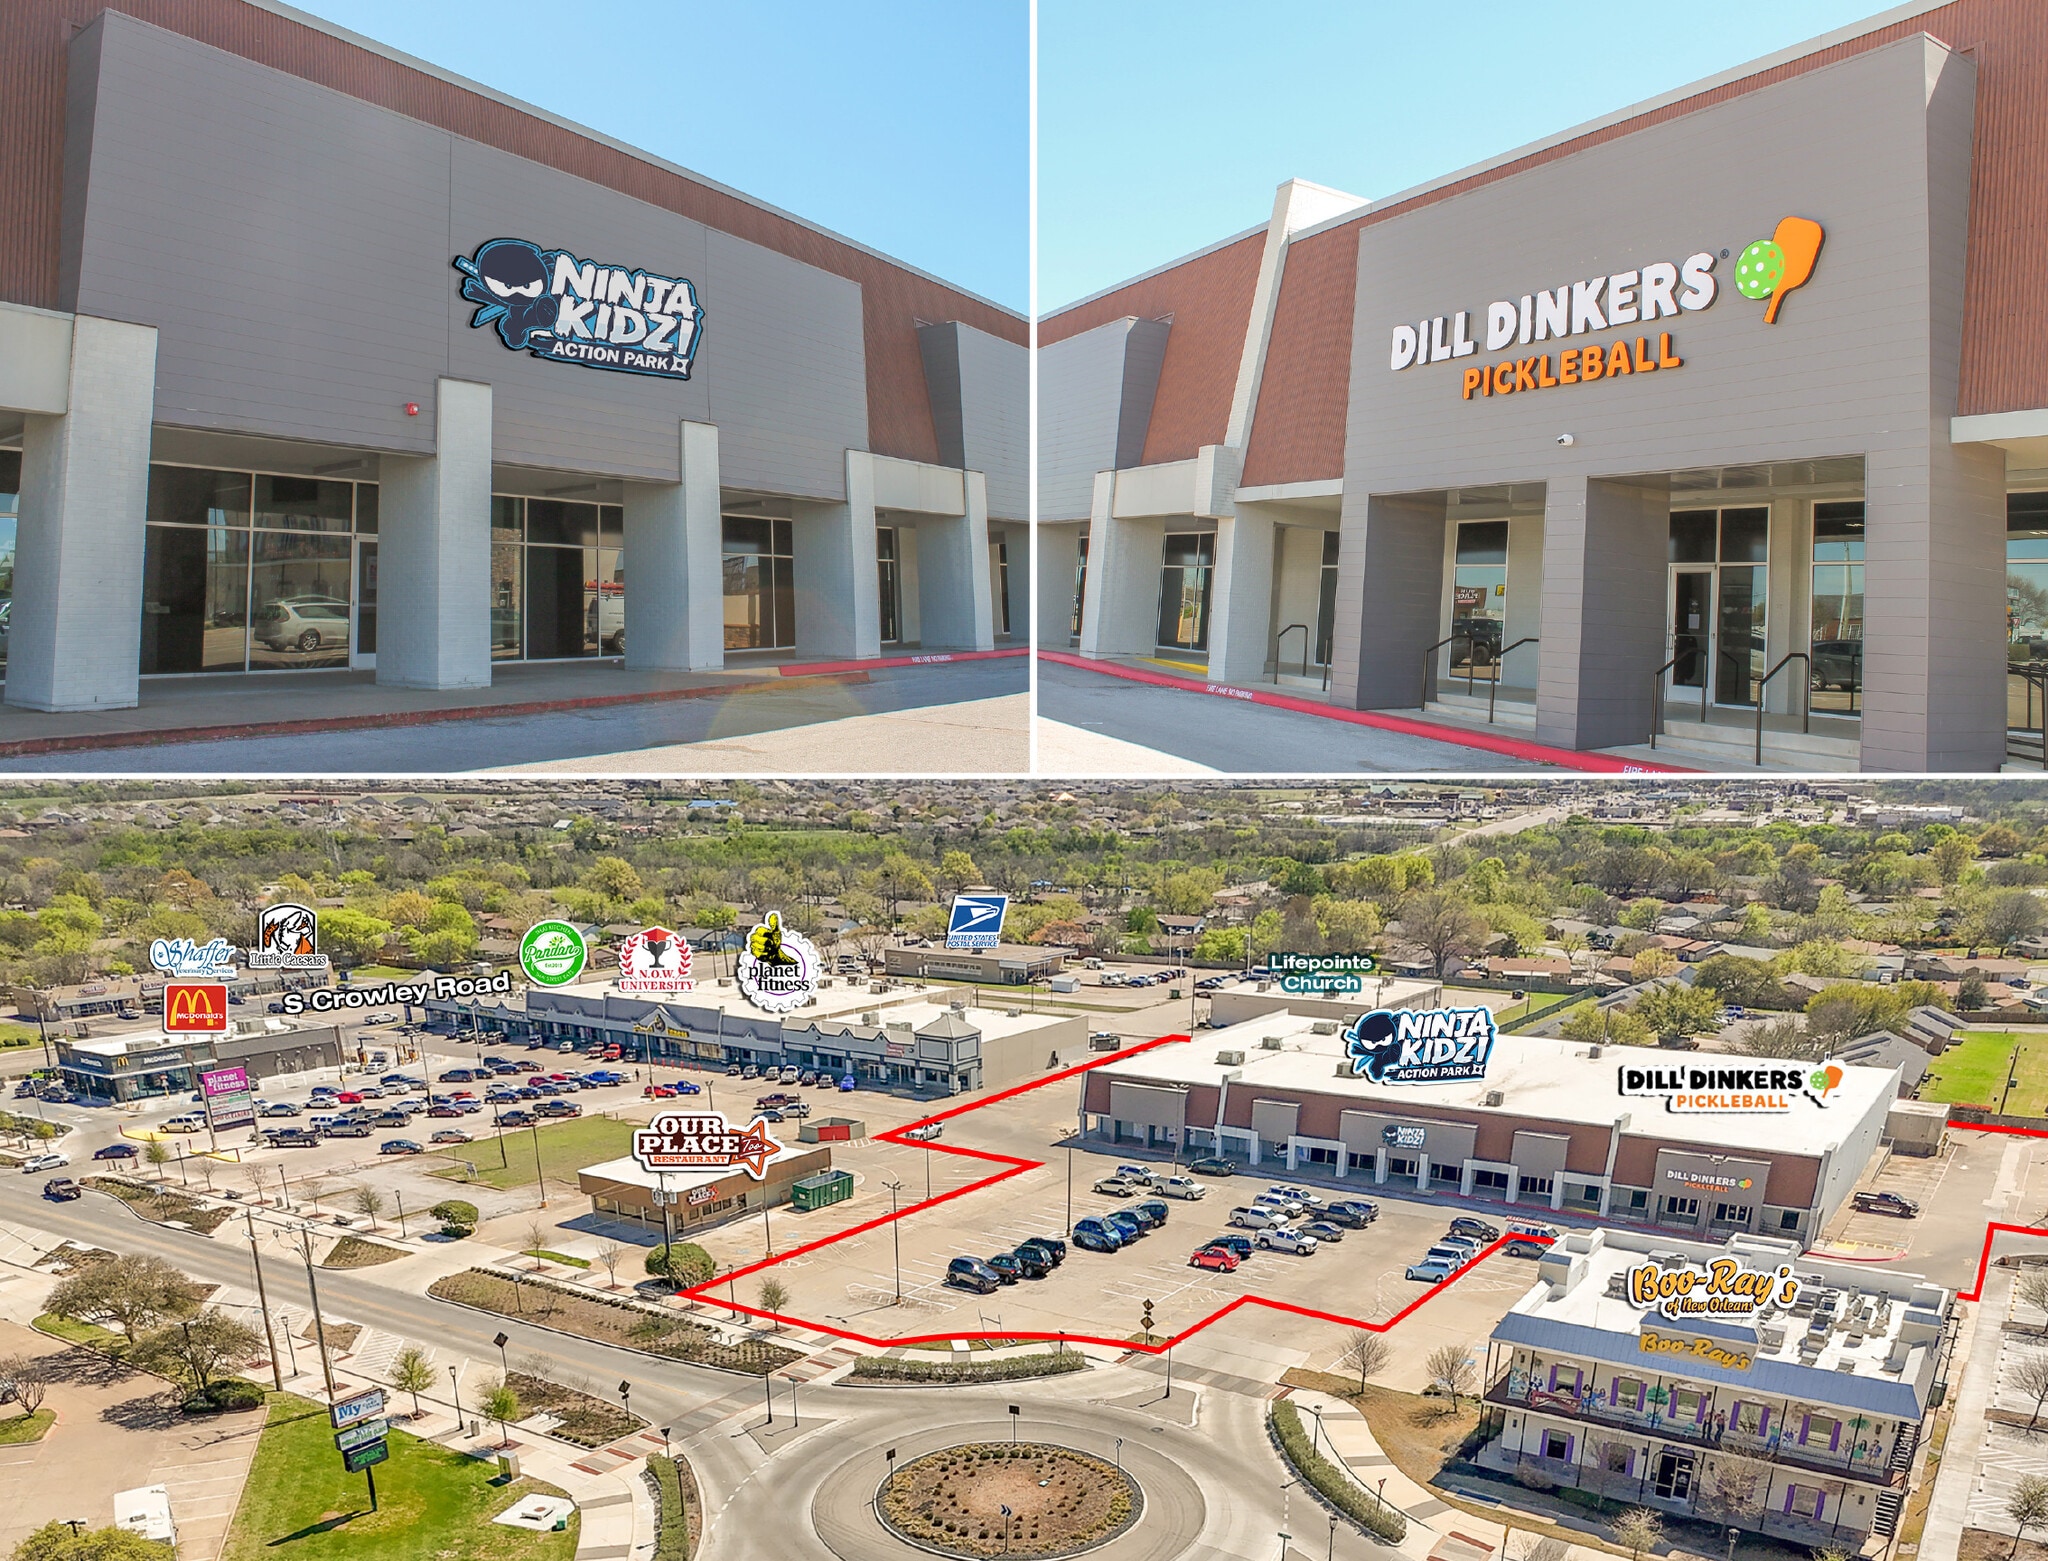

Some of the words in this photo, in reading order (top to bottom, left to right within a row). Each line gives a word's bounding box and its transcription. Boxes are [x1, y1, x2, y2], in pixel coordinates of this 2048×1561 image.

[551, 253, 698, 320] NINJA
[1390, 311, 1475, 371] DILL
[1486, 252, 1717, 352] DINKERS
[551, 341, 620, 363] ACTION
[623, 352, 668, 371] PARK
[1462, 332, 1682, 400] PICKLEBALL
[206, 1072, 239, 1087] planet
[213, 1080, 246, 1092] fitness
[1667, 1170, 1689, 1180] DILL
[1690, 1173, 1736, 1187] DINKERS
[1638, 1332, 1752, 1371] Boo-Ray's
[337, 1402, 361, 1420] My
